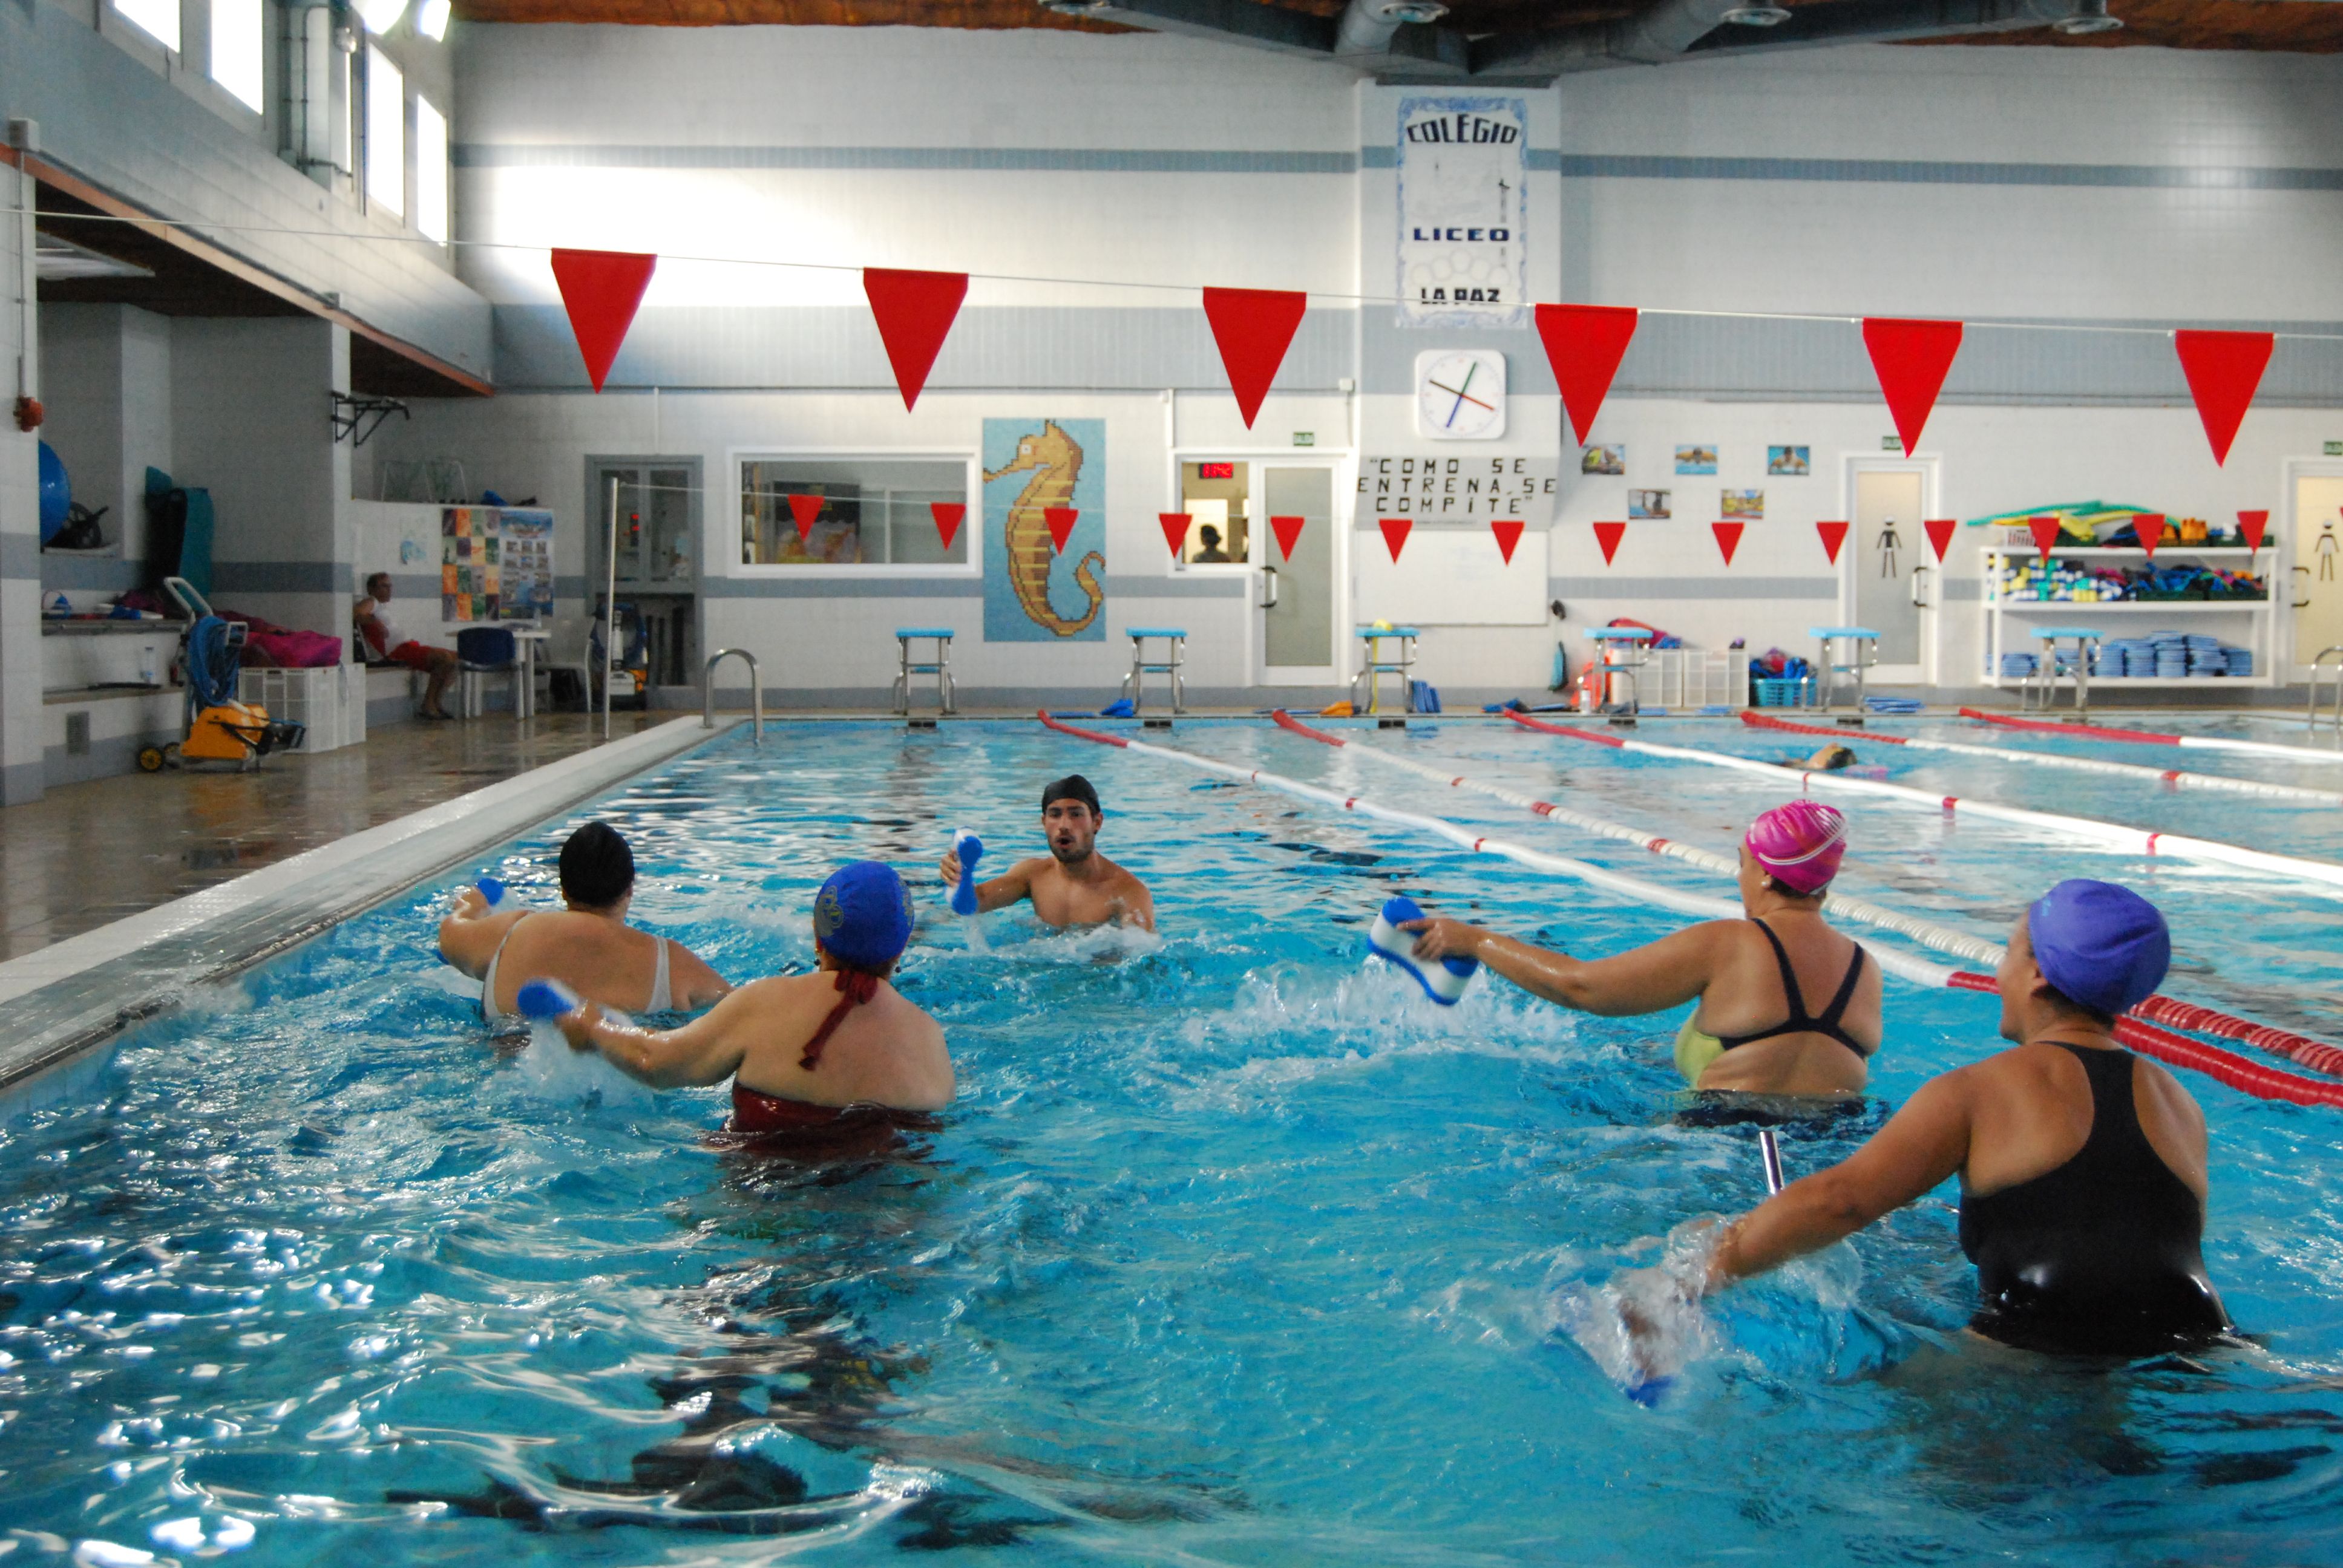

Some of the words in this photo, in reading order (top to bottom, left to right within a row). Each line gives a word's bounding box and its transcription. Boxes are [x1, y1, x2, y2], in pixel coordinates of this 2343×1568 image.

[1407, 114, 1518, 143] COLEGIO
[1414, 227, 1509, 241] LICEO
[1421, 288, 1447, 304] LA
[1454, 289, 1500, 305] PAZ
[1492, 458, 1525, 474] SE
[1523, 477, 1556, 494] SE
